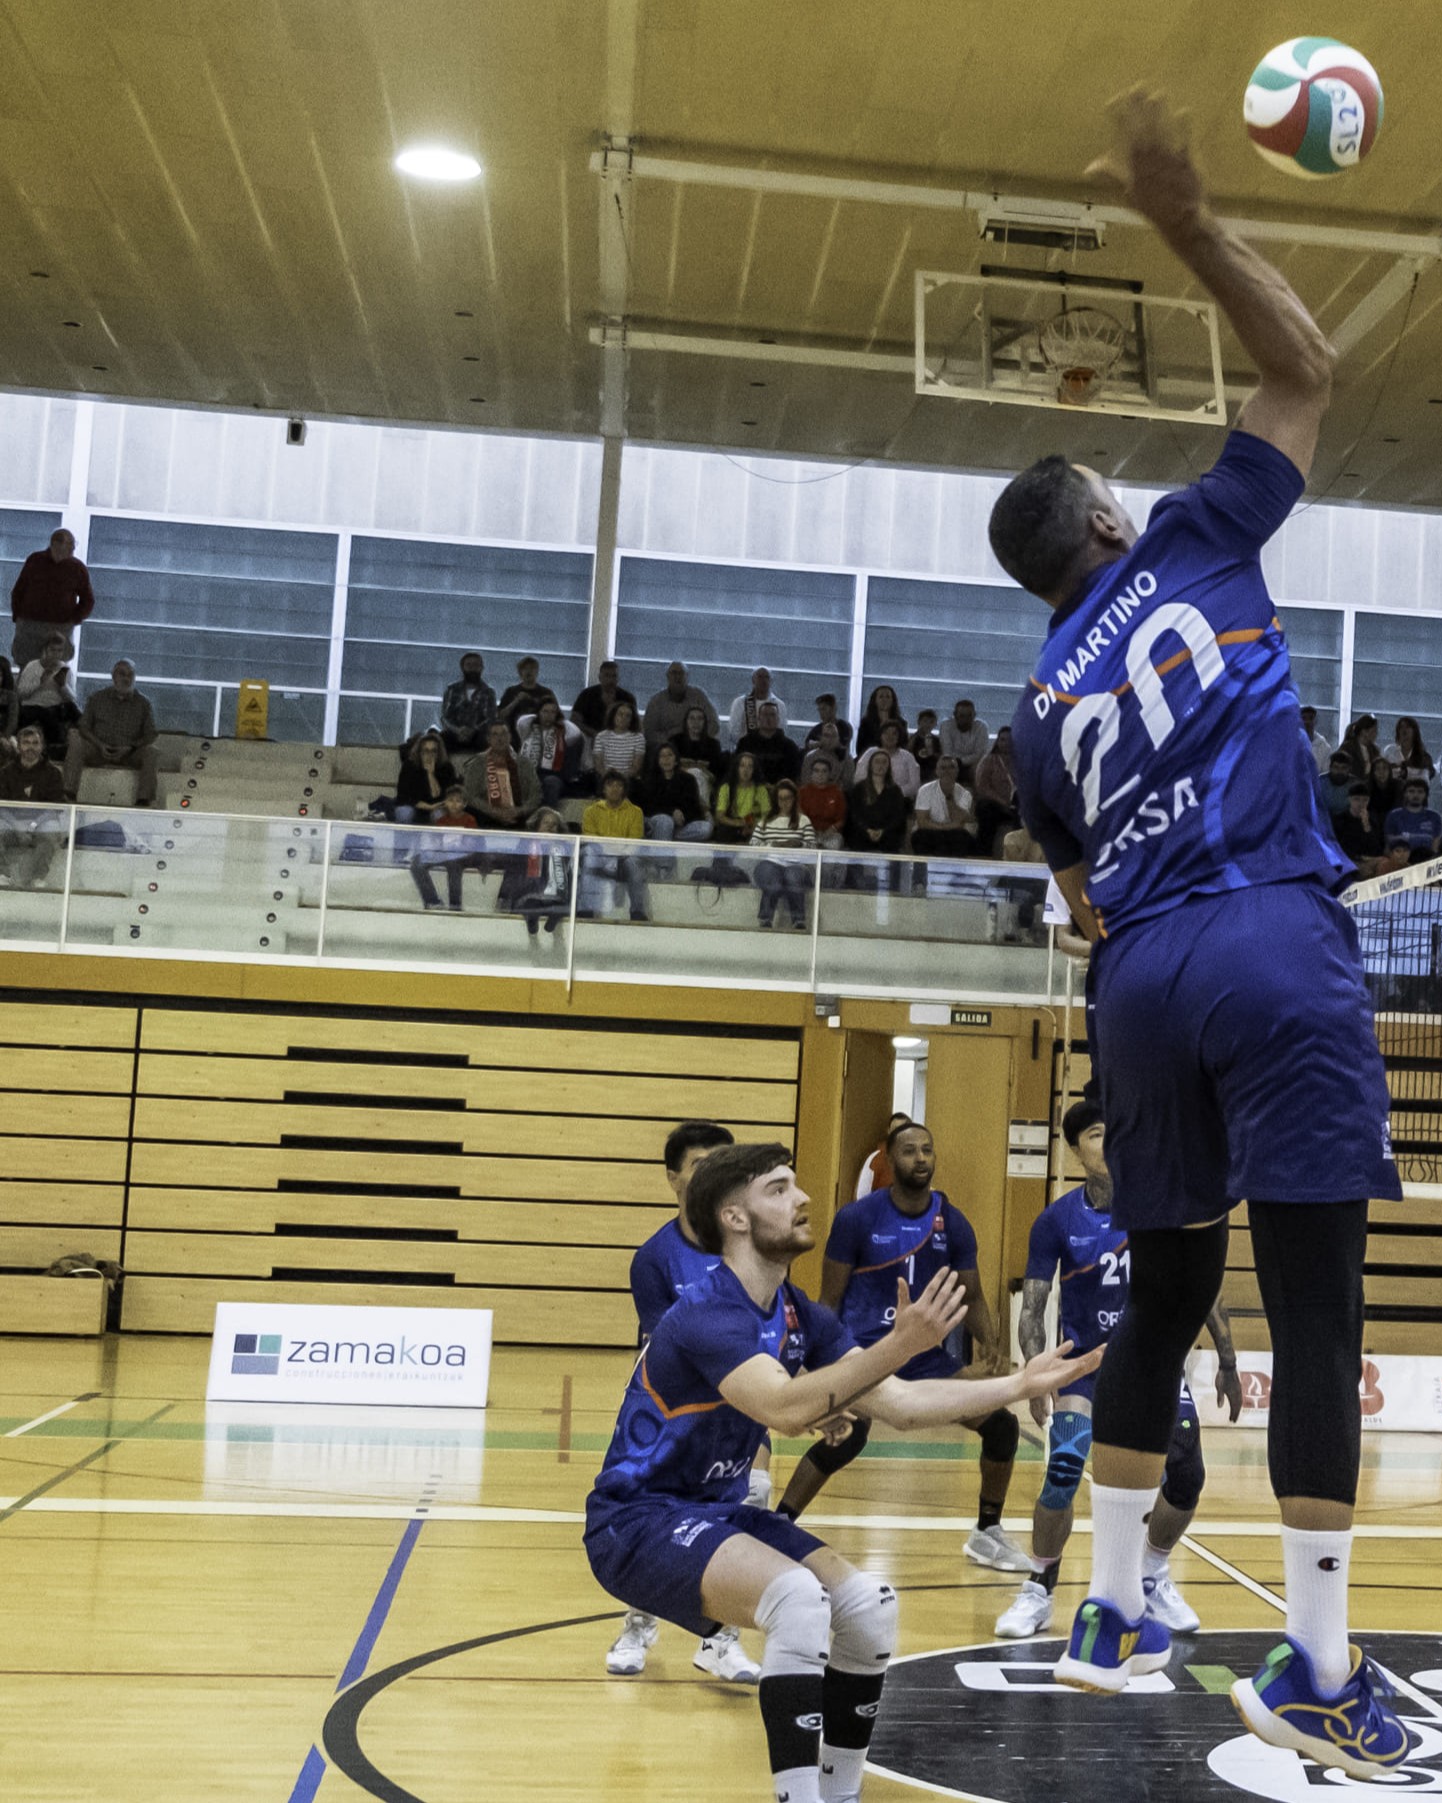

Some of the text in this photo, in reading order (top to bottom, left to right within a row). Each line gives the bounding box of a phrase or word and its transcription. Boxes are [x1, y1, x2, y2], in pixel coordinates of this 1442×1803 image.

[1032, 569, 1158, 720] DI MARTINO
[1060, 602, 1226, 827] 20
[955, 1012, 988, 1023] SALIDA
[905, 1254, 915, 1285] 1
[1100, 1249, 1132, 1285] 21
[287, 1335, 466, 1367] zamakoa
